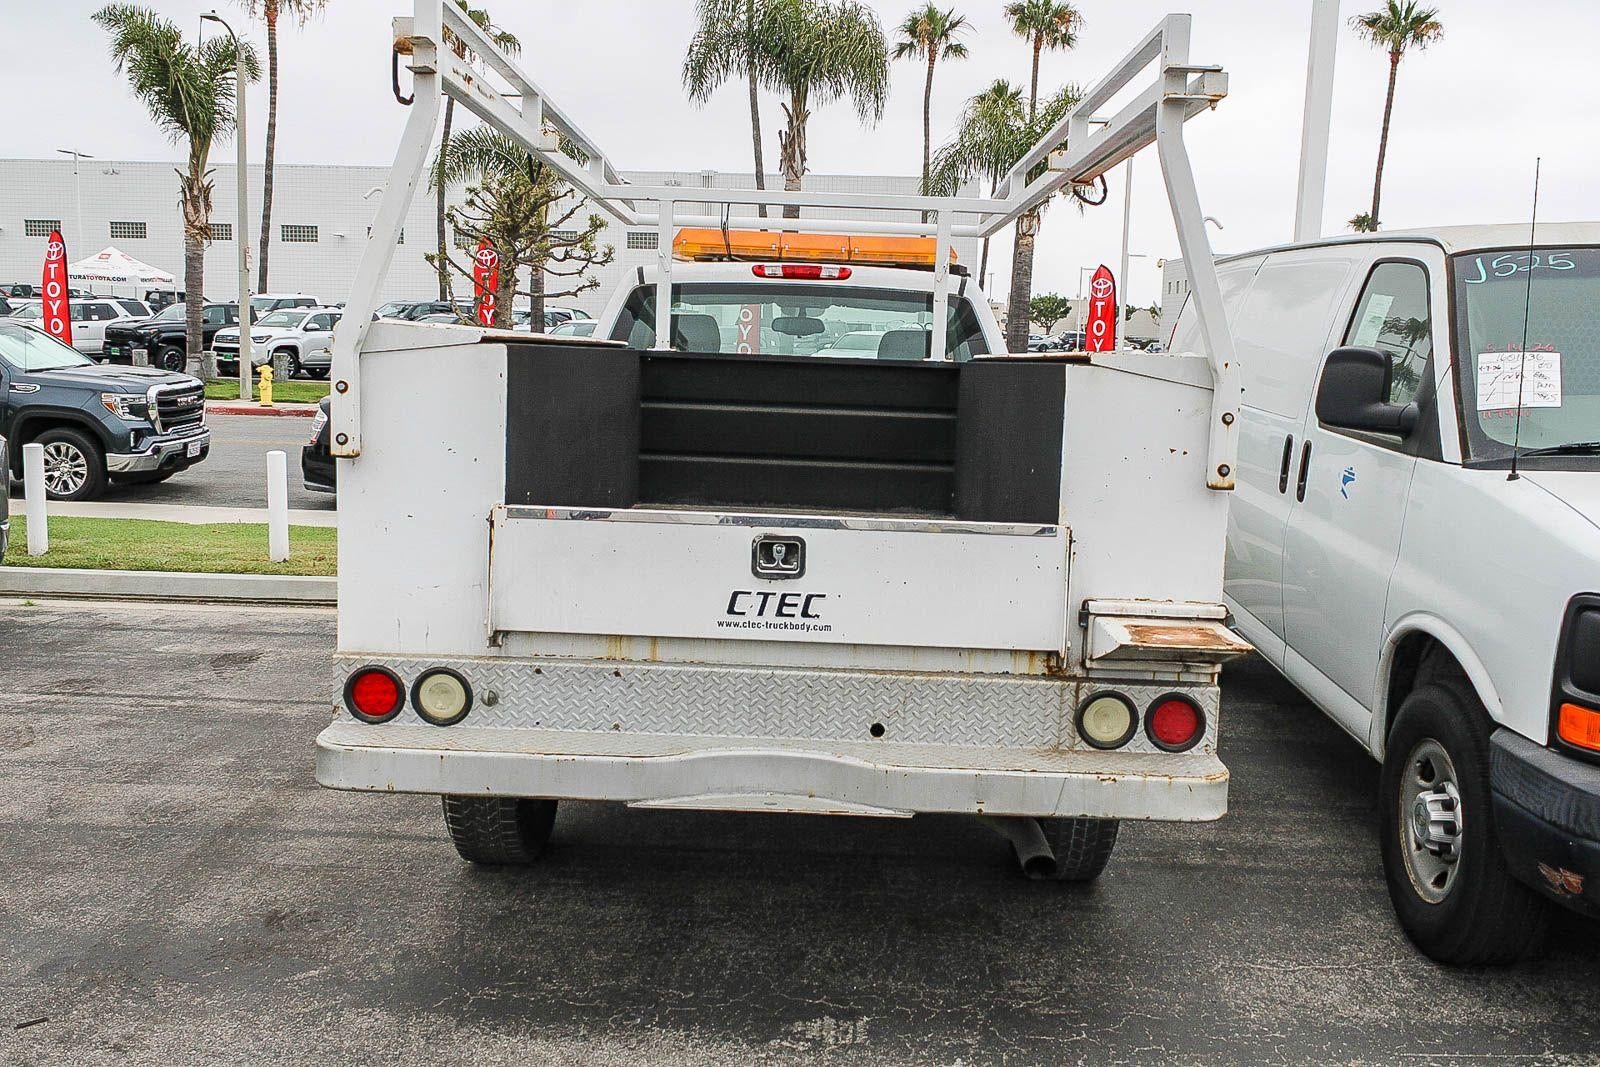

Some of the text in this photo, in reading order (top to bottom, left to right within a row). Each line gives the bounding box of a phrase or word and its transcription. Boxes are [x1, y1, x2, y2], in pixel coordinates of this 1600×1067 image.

[46, 263, 65, 341] TOYO
[1092, 301, 1106, 353] TOY
[737, 304, 753, 354] OYO
[717, 619, 832, 633] www.ctec-truckbody.com
[726, 590, 827, 619] CTEC
